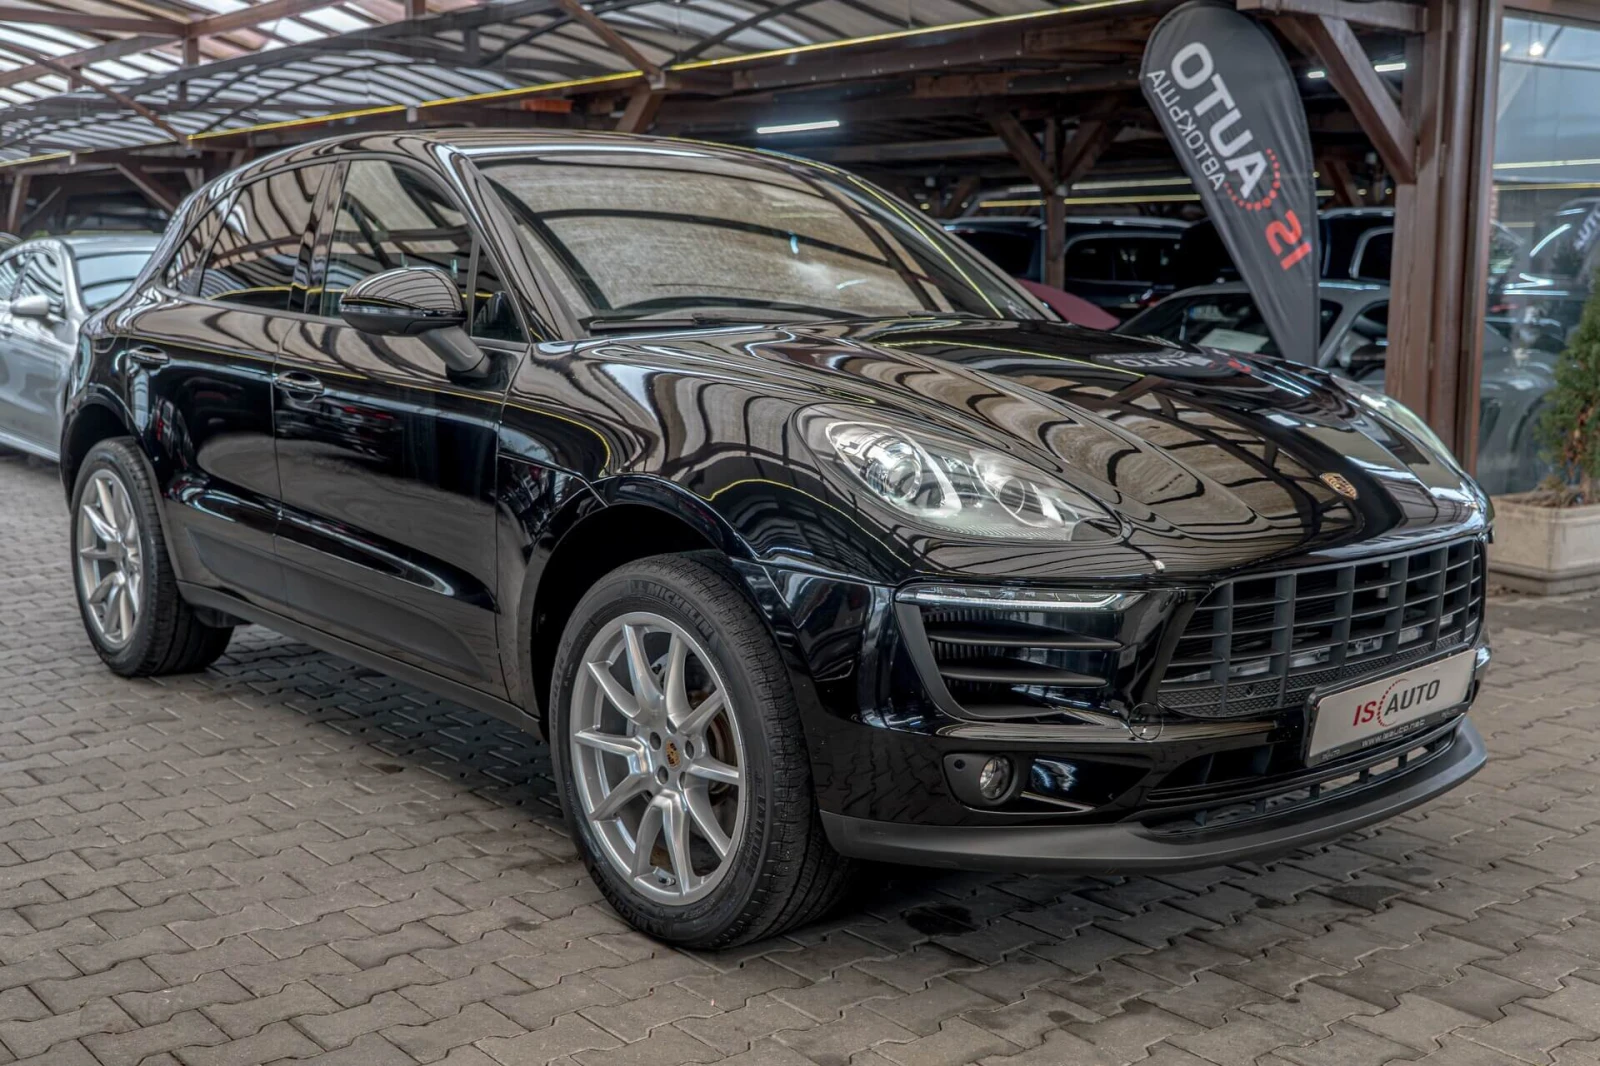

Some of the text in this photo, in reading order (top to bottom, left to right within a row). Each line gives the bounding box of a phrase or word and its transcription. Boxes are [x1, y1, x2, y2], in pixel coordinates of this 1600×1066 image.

[646, 582, 714, 638] MICHELIN
[1353, 679, 1440, 726] IS AUTO
